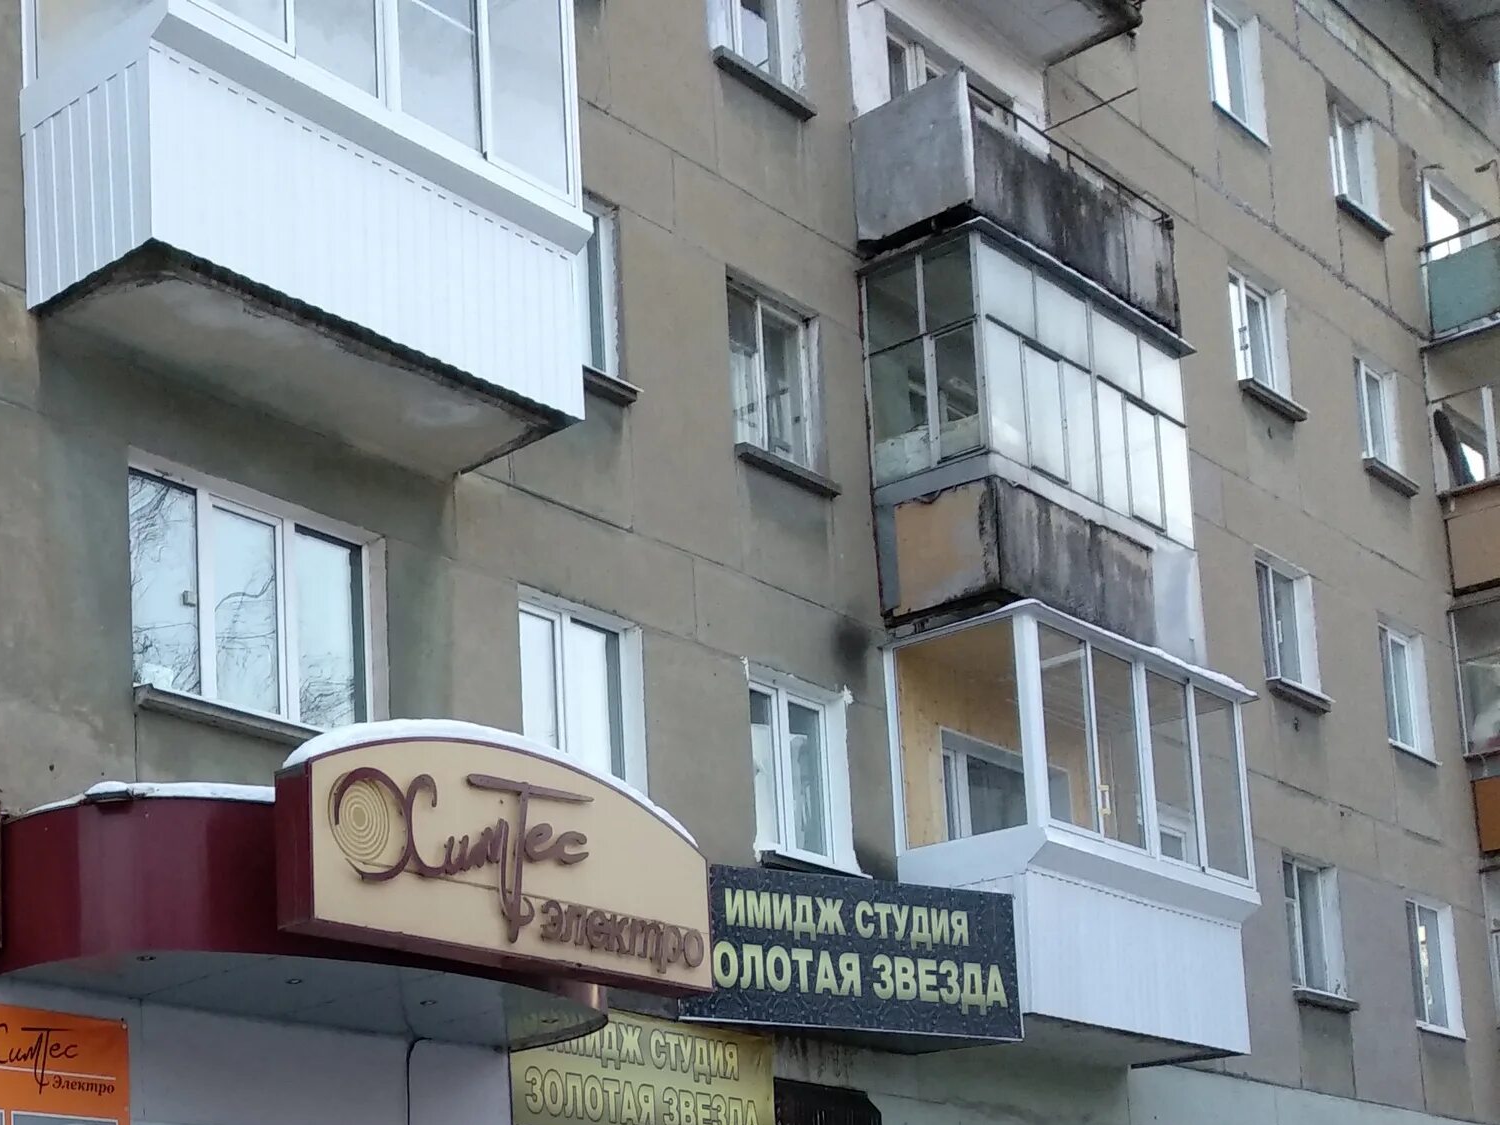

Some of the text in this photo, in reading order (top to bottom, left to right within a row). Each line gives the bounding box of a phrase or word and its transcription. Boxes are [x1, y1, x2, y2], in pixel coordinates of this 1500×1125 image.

[724, 887, 970, 951] ИМИДЖ СТУДИЯ
[713, 940, 1009, 1016] ОЛОТАЯ ЗВЕЗДА
[51, 1075, 116, 1095] Электро
[650, 1028, 740, 1085] СТУДИЯ
